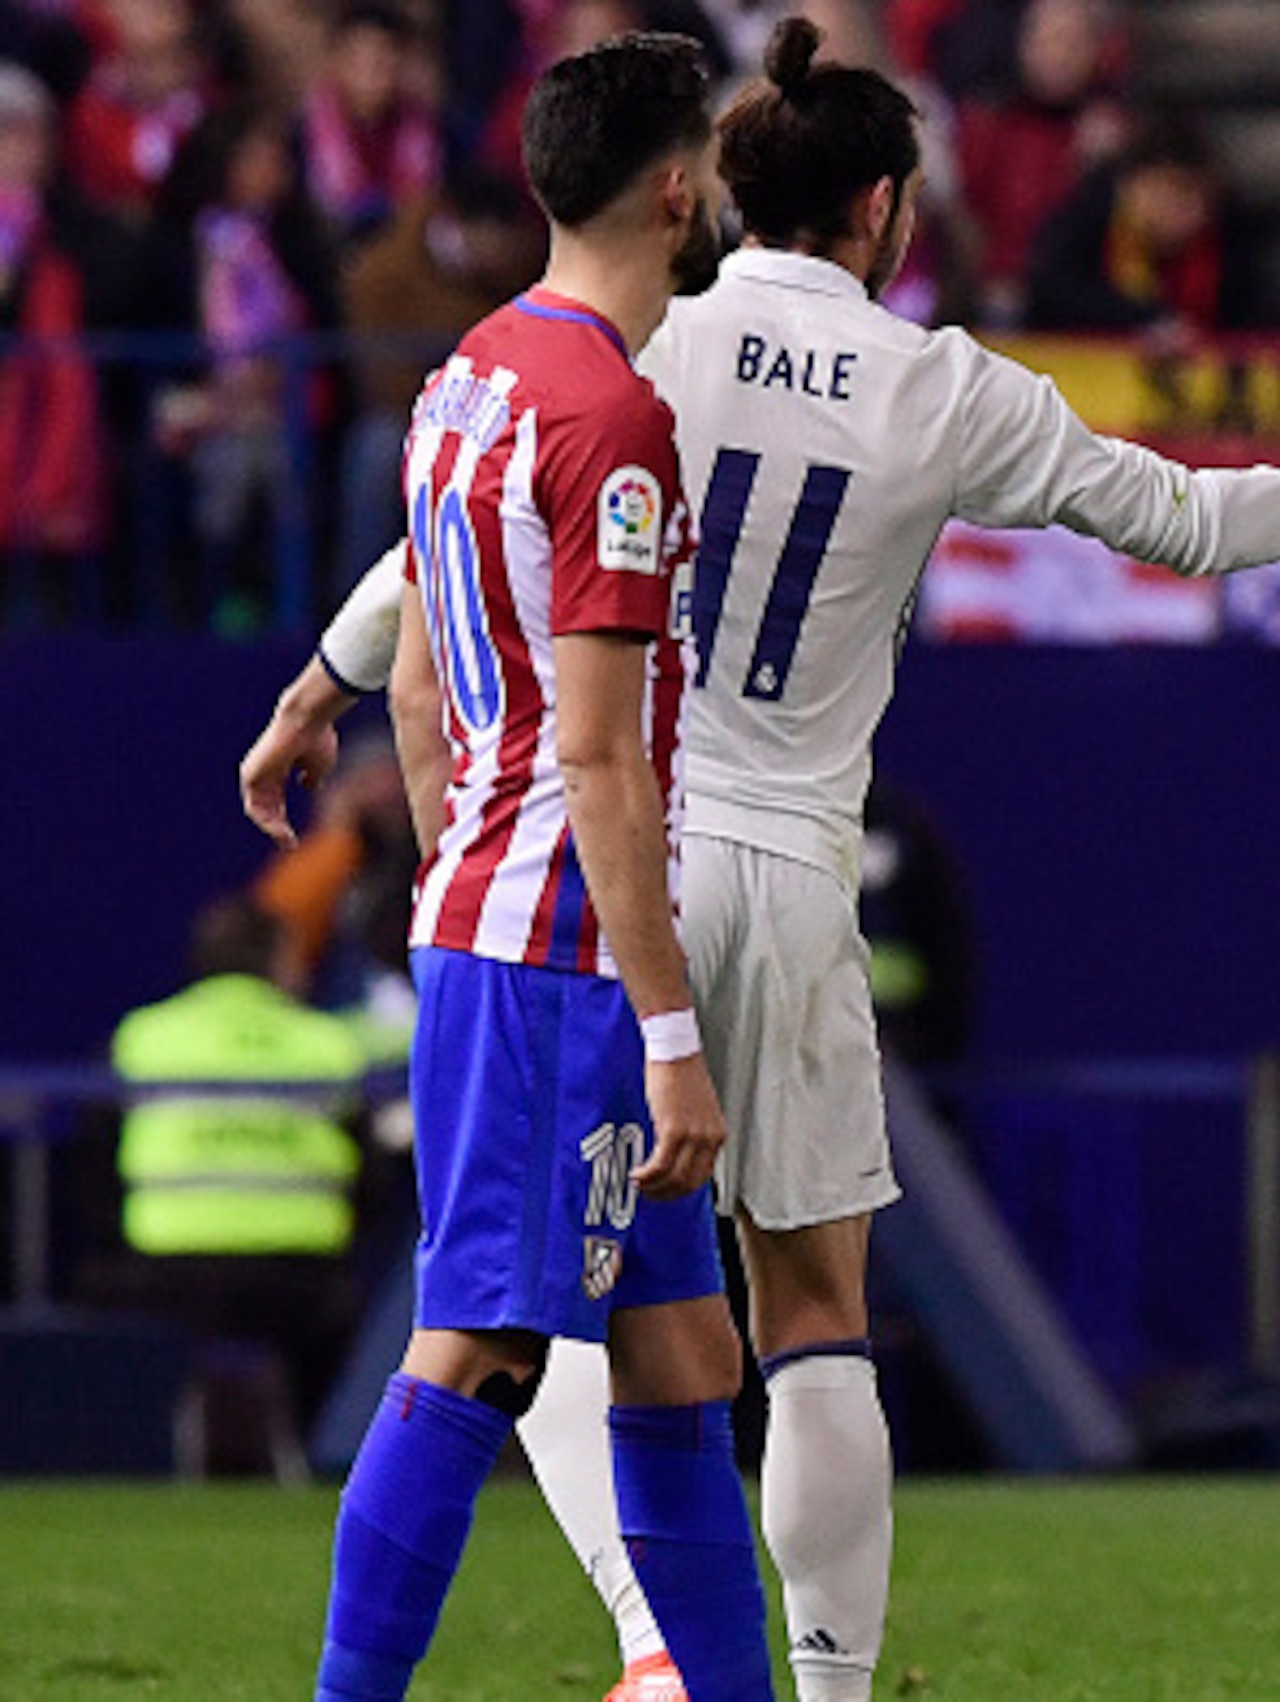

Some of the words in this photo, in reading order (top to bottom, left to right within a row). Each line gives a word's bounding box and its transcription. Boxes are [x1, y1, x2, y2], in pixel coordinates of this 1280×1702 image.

[736, 333, 857, 400] BALE
[410, 479, 506, 733] 10
[694, 447, 853, 701] 11
[579, 1121, 646, 1231] 10
